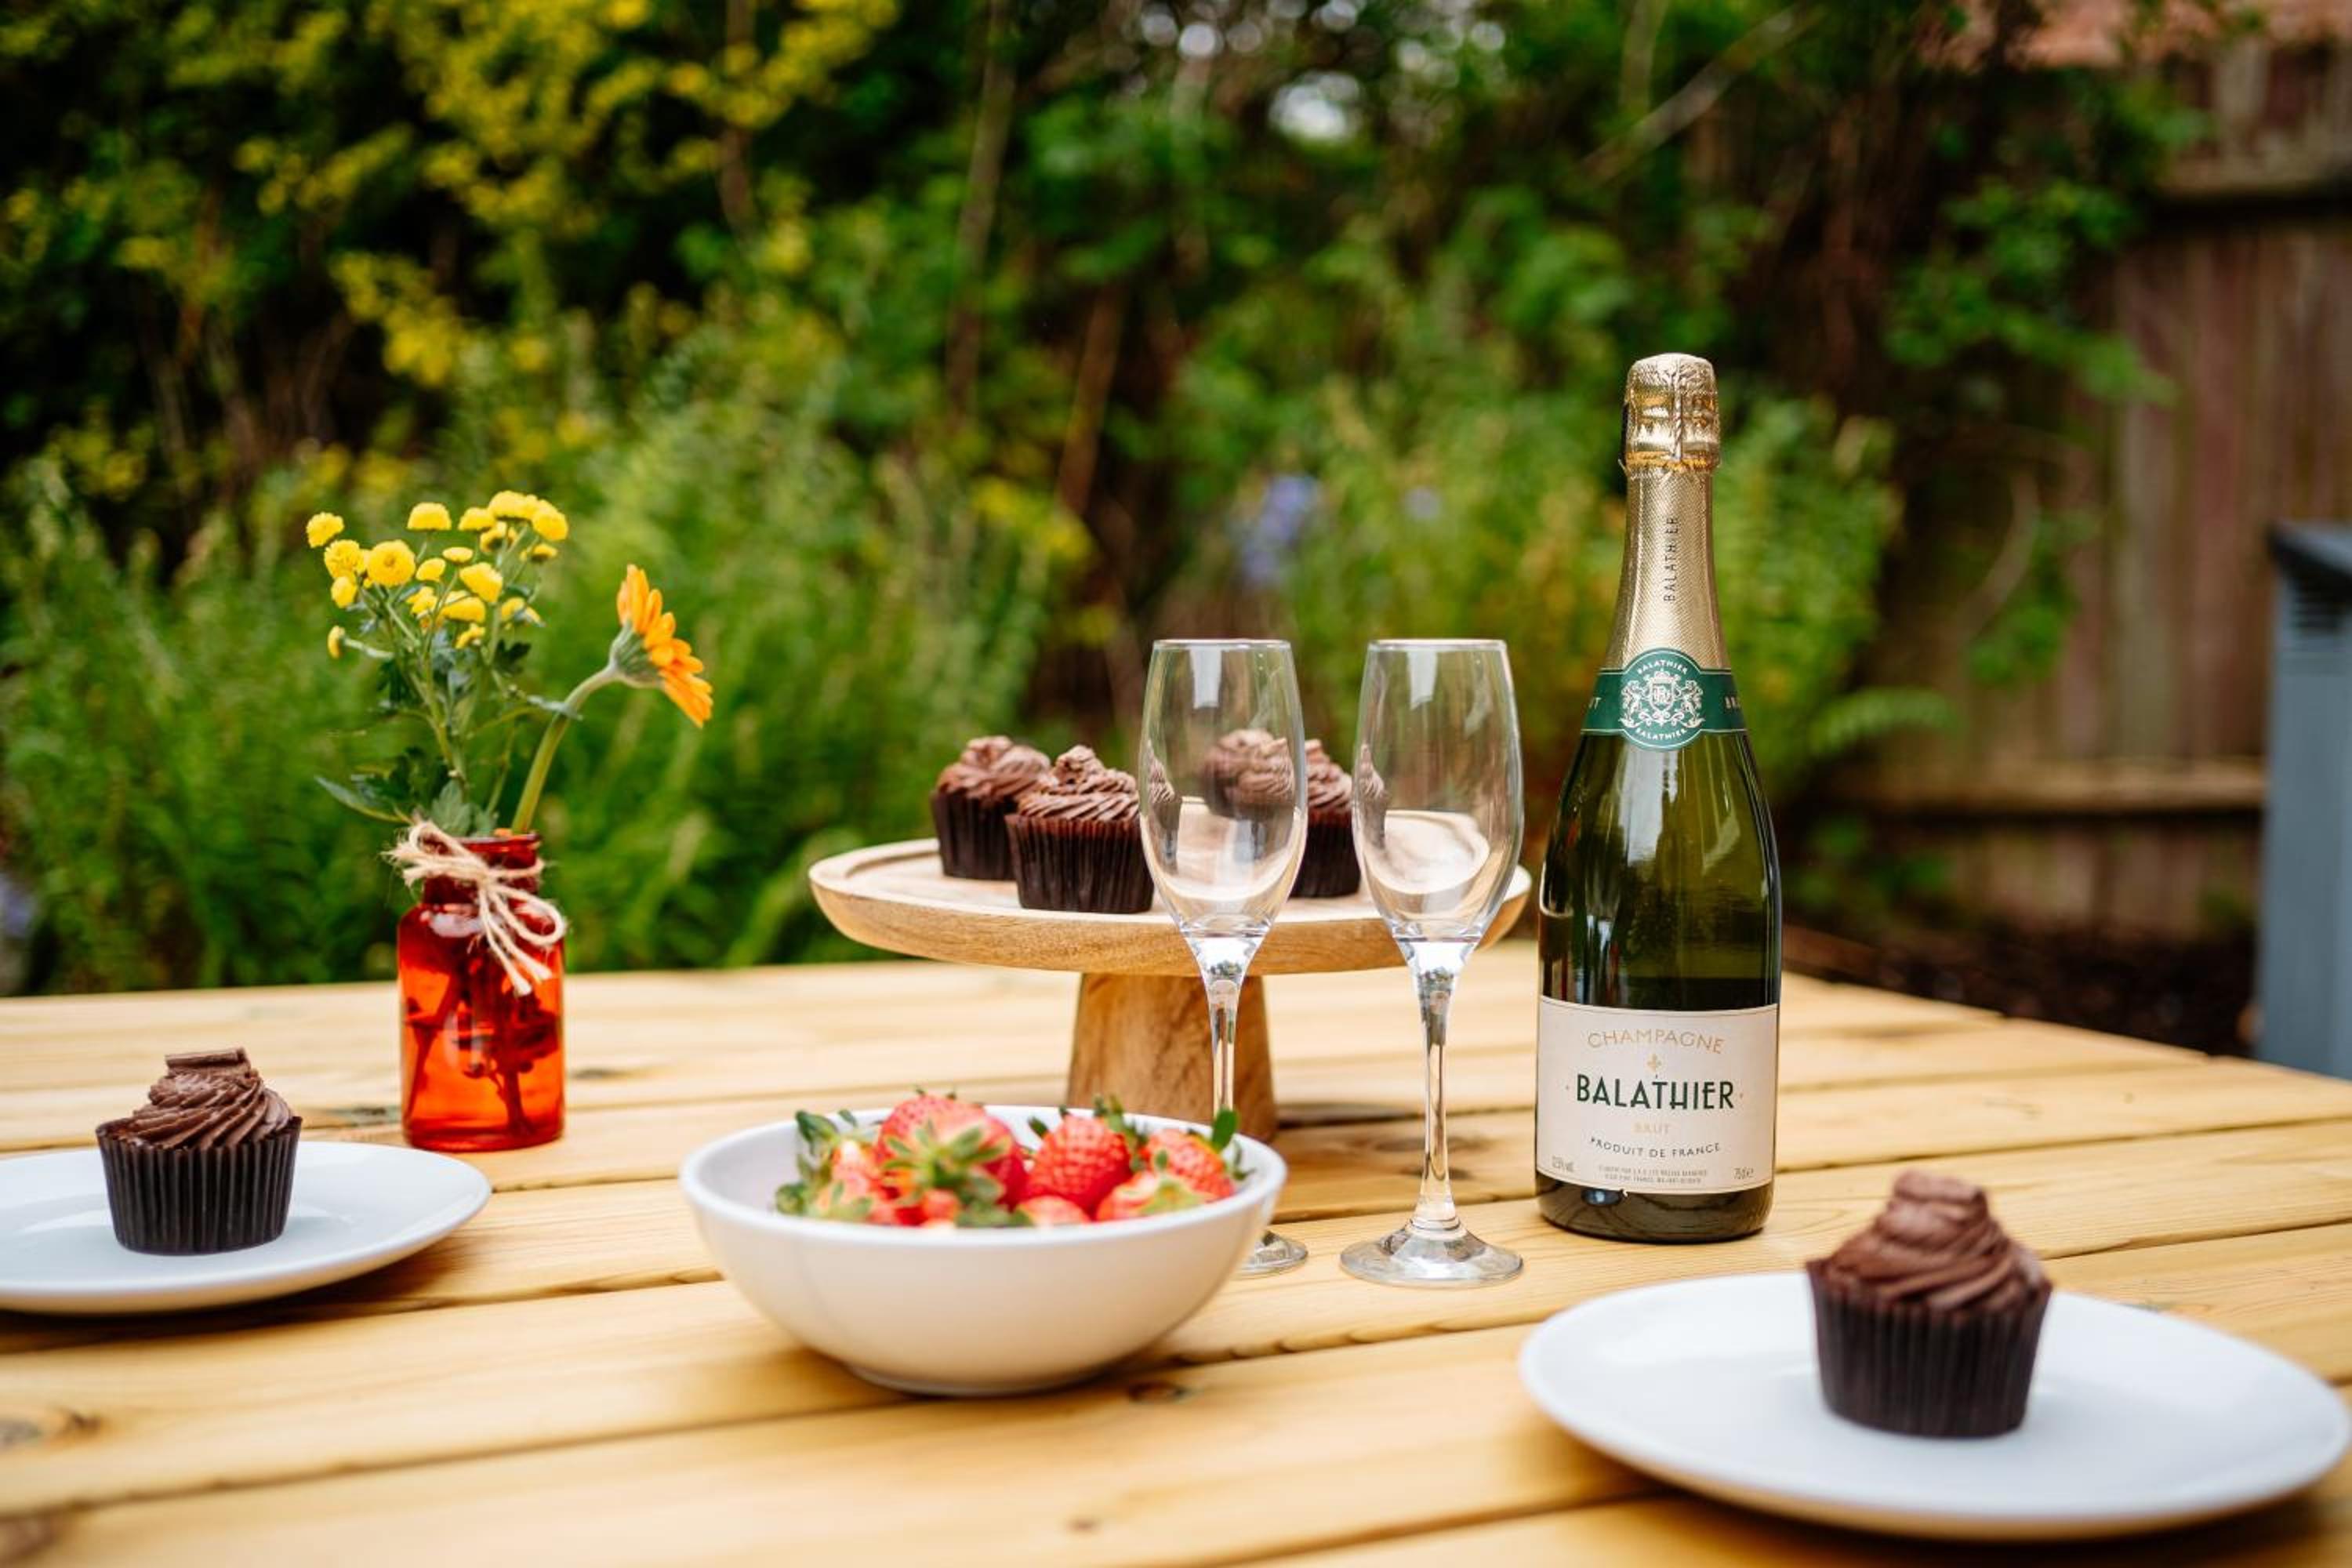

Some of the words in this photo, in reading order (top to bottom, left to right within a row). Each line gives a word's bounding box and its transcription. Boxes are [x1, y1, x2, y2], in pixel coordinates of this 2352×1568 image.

[1588, 1029, 1725, 1054] CHAMPAGNE
[1577, 1073, 1734, 1110] BALATHIER
[1591, 1137, 1644, 1157] PRODUIT
[1649, 1148, 1666, 1158] DE
[1671, 1143, 1720, 1157] FRANCE
